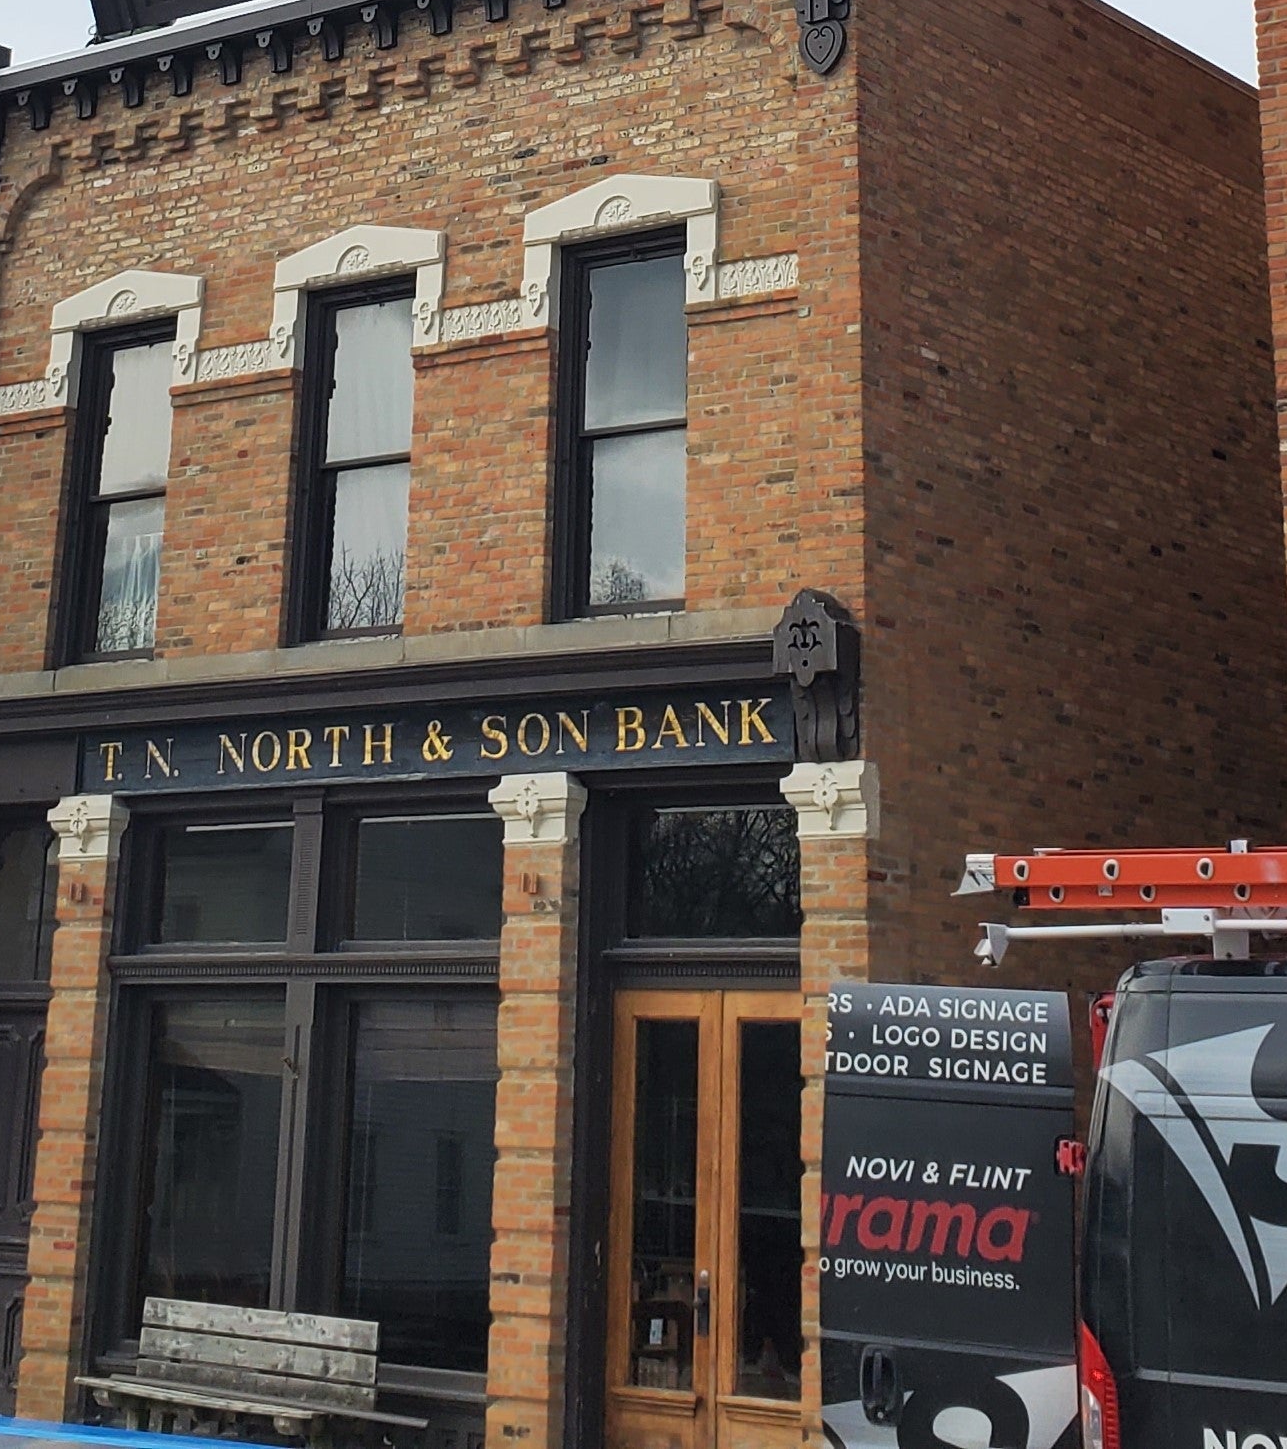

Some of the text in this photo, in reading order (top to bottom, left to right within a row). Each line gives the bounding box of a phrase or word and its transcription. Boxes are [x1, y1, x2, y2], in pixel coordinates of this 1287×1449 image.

[100, 697, 778, 781] T. N. NORTH & SON BANK
[879, 995, 931, 1018] ADA
[938, 998, 1049, 1023] SIGNAGE
[872, 1024, 941, 1047] LOGO
[951, 1028, 1047, 1054] DESIGN
[928, 1057, 1047, 1085] SIGNAGE
[846, 1155, 1032, 1191] NOVI & FLINT
[834, 1257, 881, 1278] grow
[884, 1260, 928, 1282] your
[931, 1260, 1021, 1291] business.
